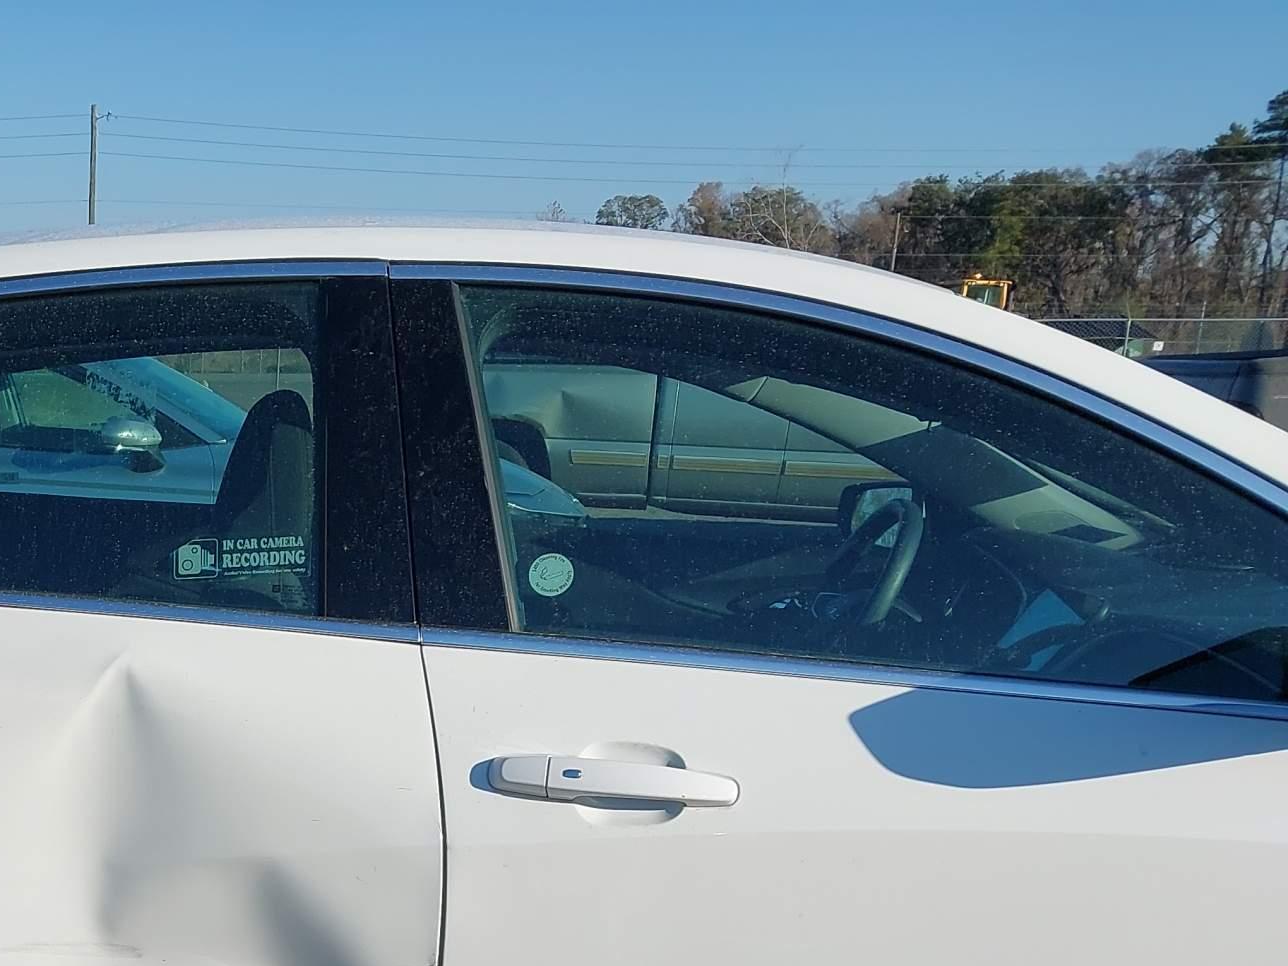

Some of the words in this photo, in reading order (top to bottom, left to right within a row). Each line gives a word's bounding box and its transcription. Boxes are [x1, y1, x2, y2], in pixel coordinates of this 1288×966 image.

[223, 540, 234, 551] IN
[236, 538, 259, 549] CAR
[261, 536, 304, 549] CAMERA
[222, 550, 305, 568] RECORDING
